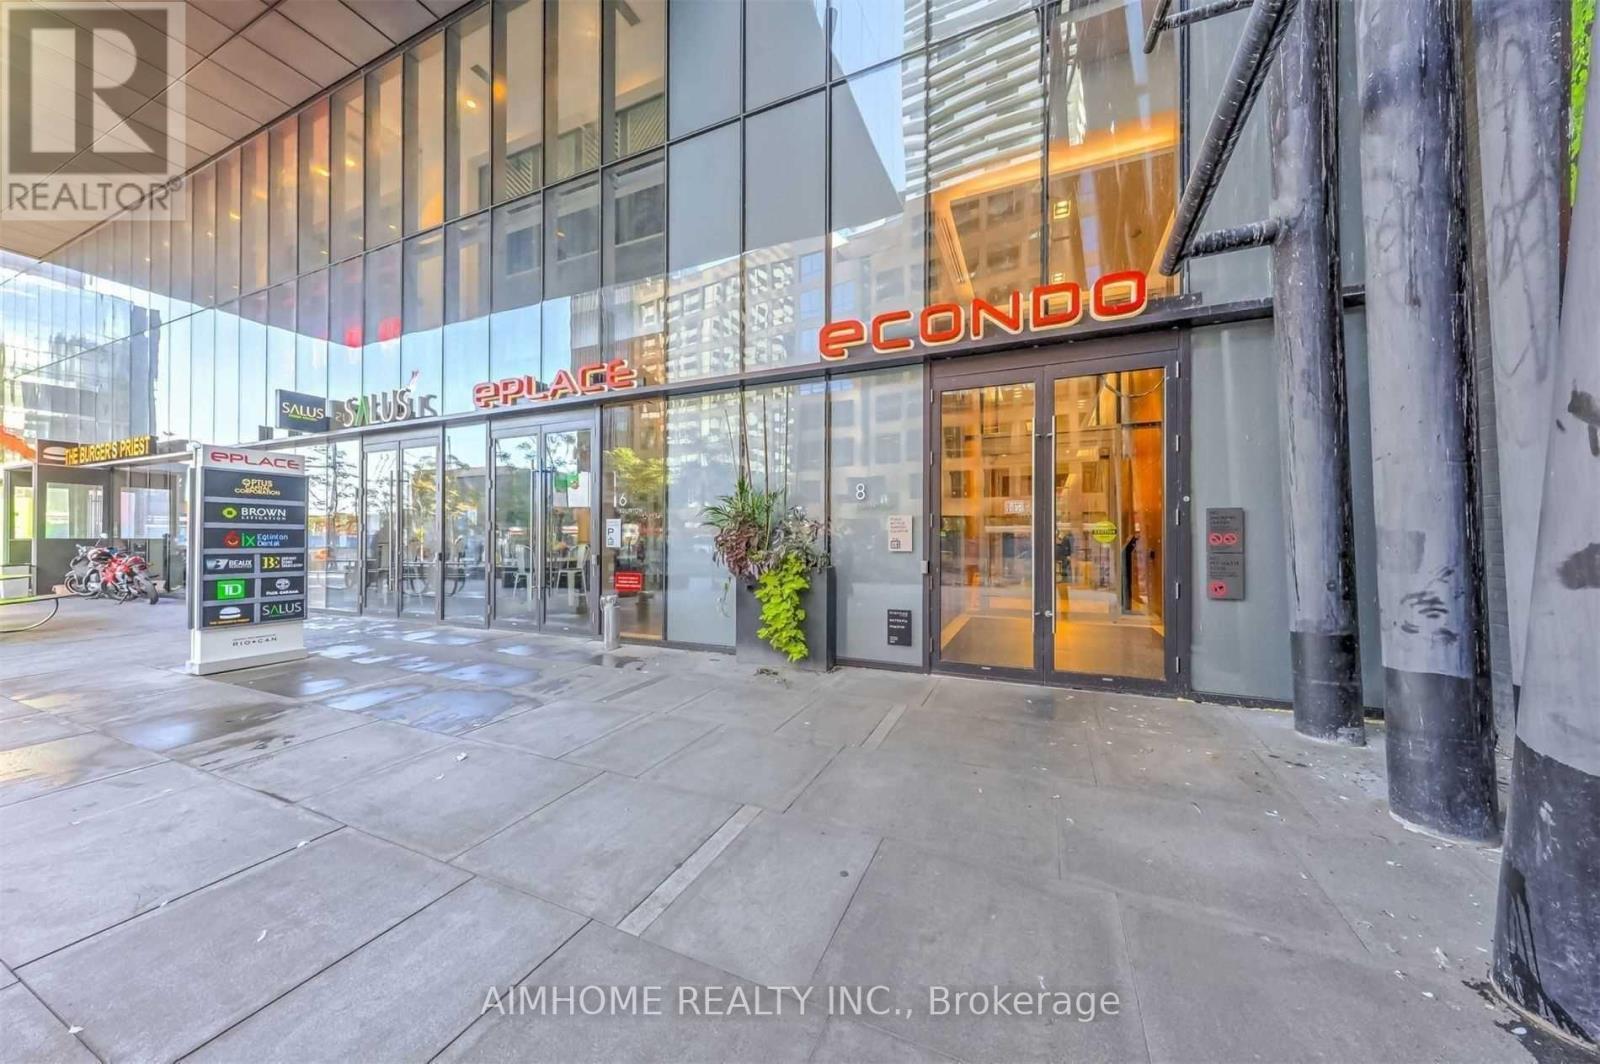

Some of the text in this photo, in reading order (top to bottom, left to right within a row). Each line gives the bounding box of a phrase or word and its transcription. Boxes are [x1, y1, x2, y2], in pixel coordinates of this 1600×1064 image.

[282, 401, 324, 420] SALUS
[344, 388, 411, 427] SALUS
[65, 436, 150, 465] THE BURGER'S PRIEST
[241, 478, 273, 488] OPTUS
[234, 487, 281, 496] CORPORATION
[855, 483, 866, 500] 8
[619, 493, 627, 506] 6
[241, 507, 287, 516] BROWN
[608, 528, 614, 536] P
[218, 583, 243, 596] TD
[262, 602, 302, 616] SALUS
